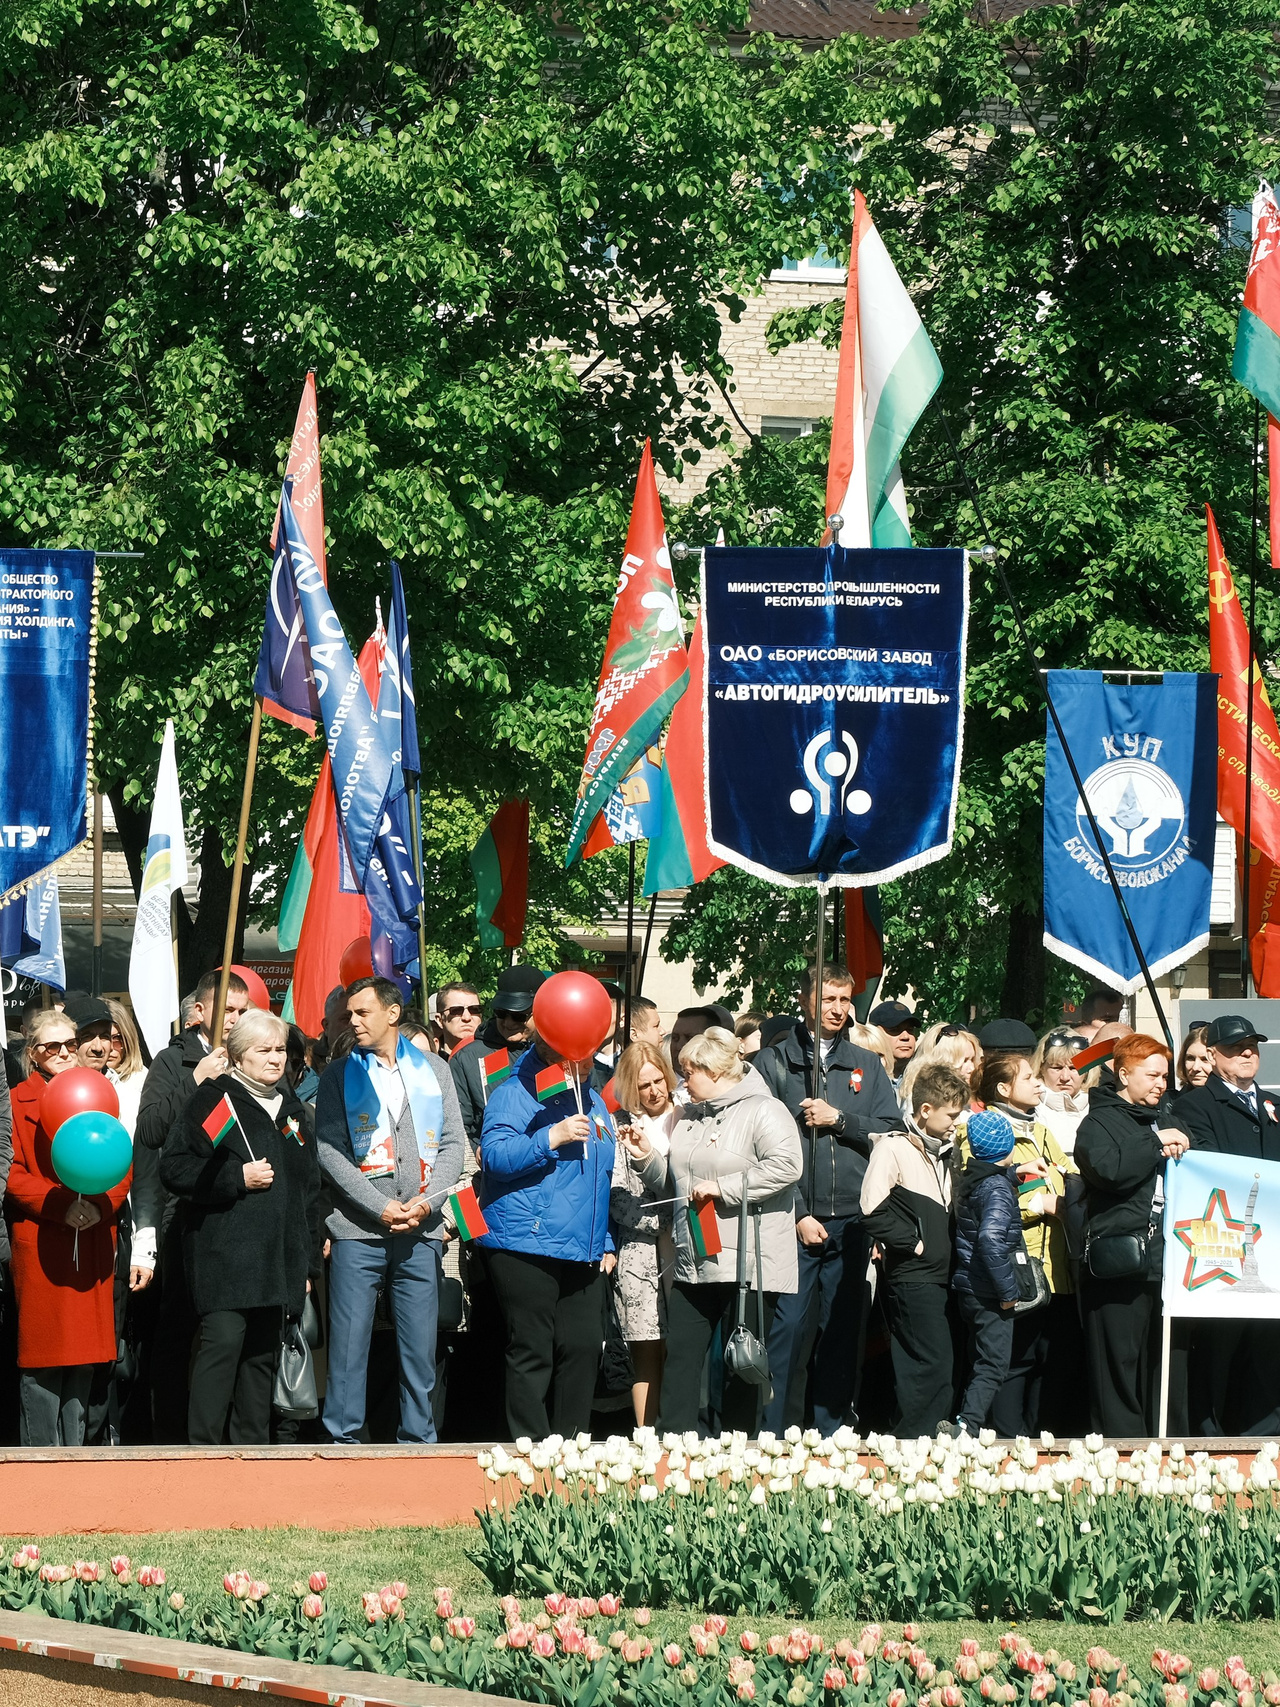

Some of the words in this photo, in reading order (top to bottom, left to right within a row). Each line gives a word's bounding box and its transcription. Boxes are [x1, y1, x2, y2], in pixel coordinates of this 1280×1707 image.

[2, 573, 59, 586] ОБЩЕСТВО
[727, 582, 826, 593] МИНИСТЕРСТВО
[764, 595, 844, 607] РЕСПУБЛИКИ
[845, 596, 904, 607] БЕЛАРУСЬ
[14, 616, 75, 628] ХОЛДИНГА
[720, 645, 763, 662] ОАО
[767, 648, 878, 663] «БОРИСОВСКИЙ
[881, 651, 933, 667] ЗАВОД
[714, 684, 950, 705] «АВТОГИДРОУСИЛИТЕЛЬ»
[1101, 732, 1164, 763] КУП
[1190, 1220, 1219, 1244] 80
[1190, 1244, 1244, 1258] ПОБЕДЫ
